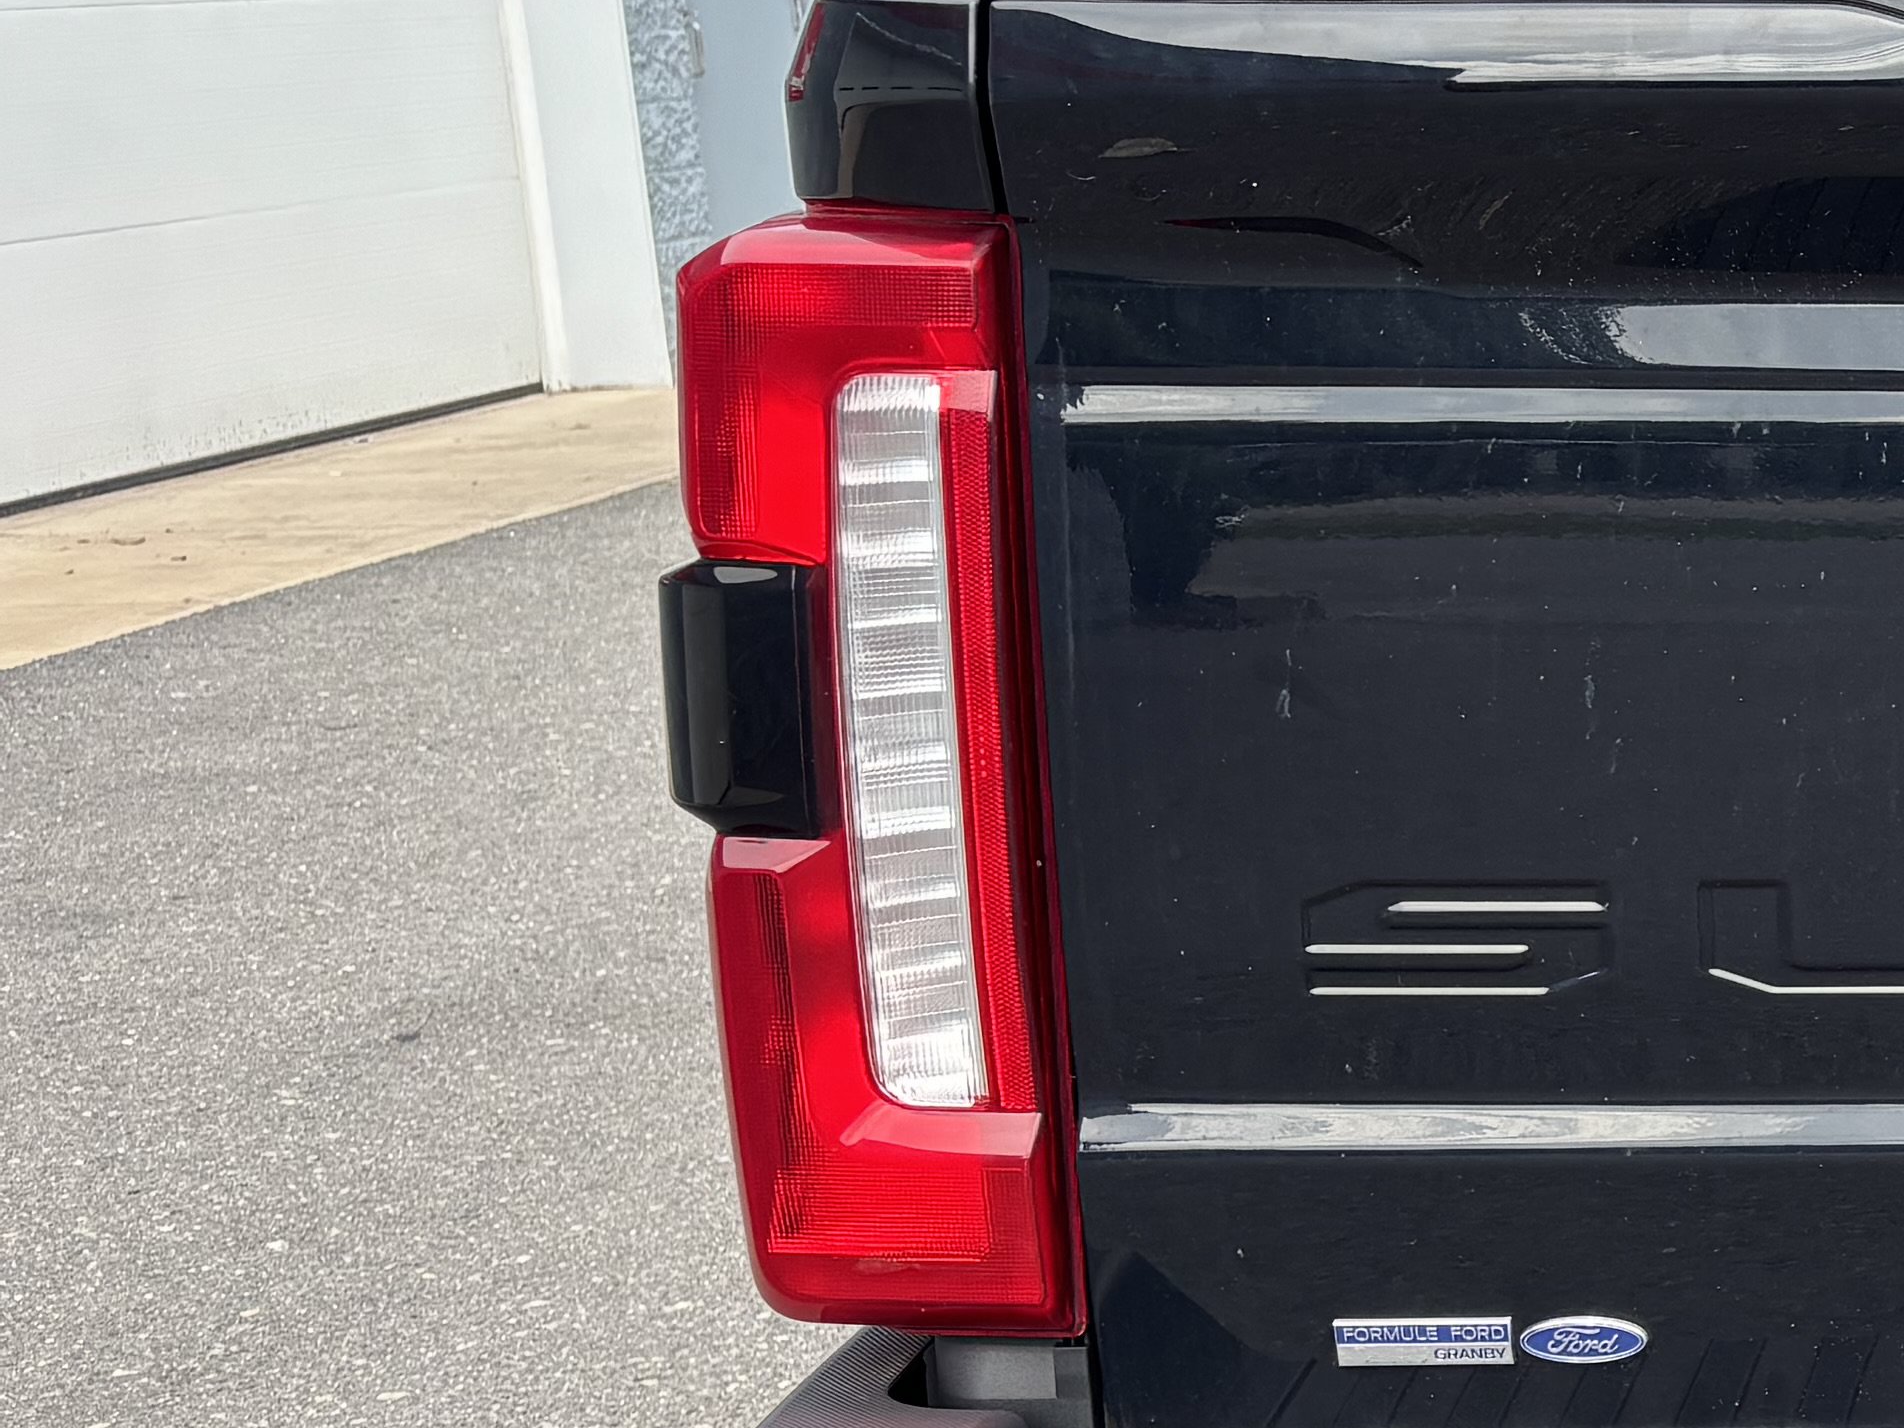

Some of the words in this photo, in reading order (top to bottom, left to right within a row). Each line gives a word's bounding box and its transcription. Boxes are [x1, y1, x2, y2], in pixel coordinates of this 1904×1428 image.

[1343, 1326, 1438, 1342] FORMULE
[1450, 1326, 1505, 1341] FORD
[1547, 1326, 1620, 1355] Ford
[1433, 1345, 1507, 1361] GRANBY
